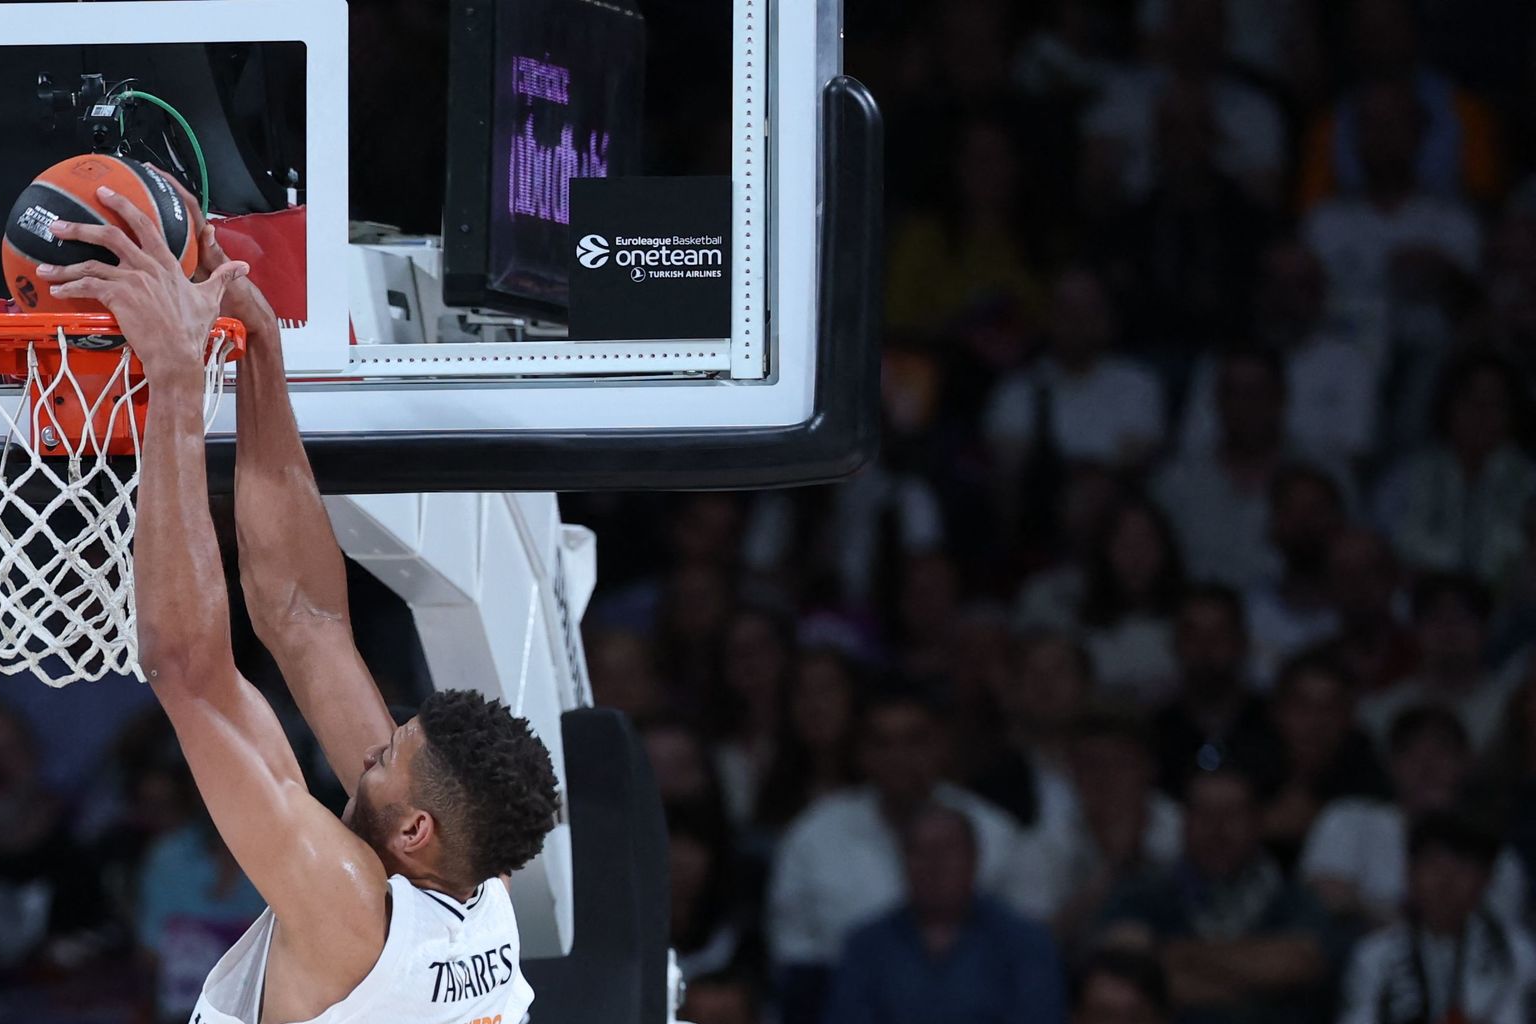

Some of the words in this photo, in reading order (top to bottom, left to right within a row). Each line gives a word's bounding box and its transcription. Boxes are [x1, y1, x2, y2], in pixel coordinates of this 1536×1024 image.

[615, 236, 672, 248] Euroleague
[672, 235, 723, 245] Basketball
[615, 245, 723, 266] oneteam
[648, 270, 684, 279] TURKISH
[685, 270, 722, 278] AIRLINES
[427, 943, 512, 1003] TAVARES
